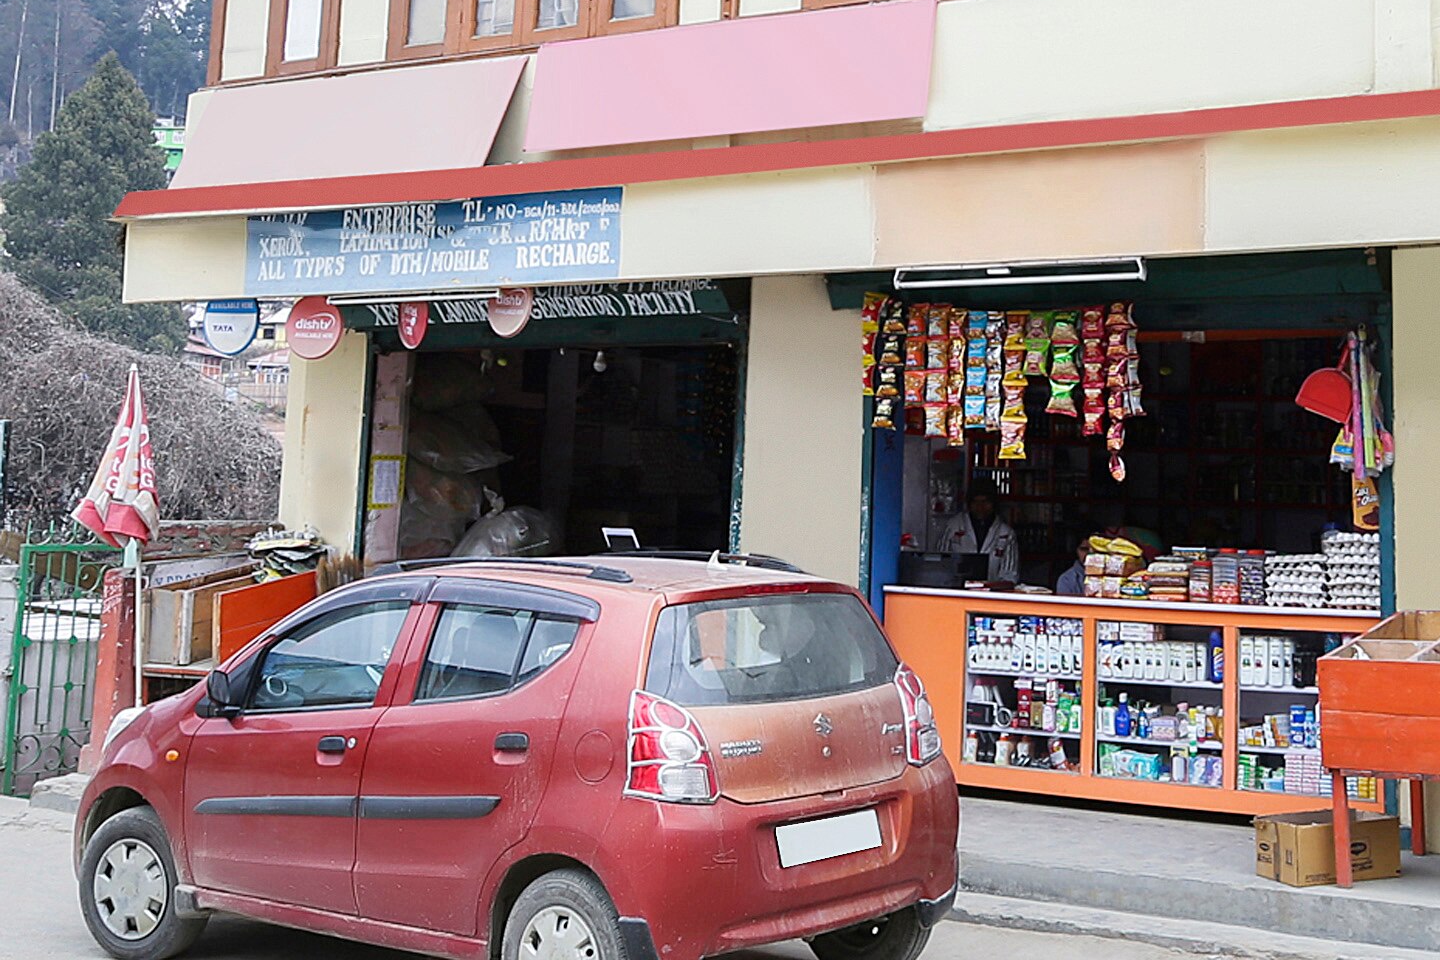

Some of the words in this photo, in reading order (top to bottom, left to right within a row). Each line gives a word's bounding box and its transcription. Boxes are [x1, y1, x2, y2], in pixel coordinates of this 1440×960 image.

[343, 202, 437, 232] ENTERPRISE
[257, 261, 286, 281] ALL
[294, 255, 345, 279] TYPES
[359, 254, 381, 276] OF
[390, 247, 490, 276] DTH/MOBILE
[516, 241, 616, 269] RECHARGE.
